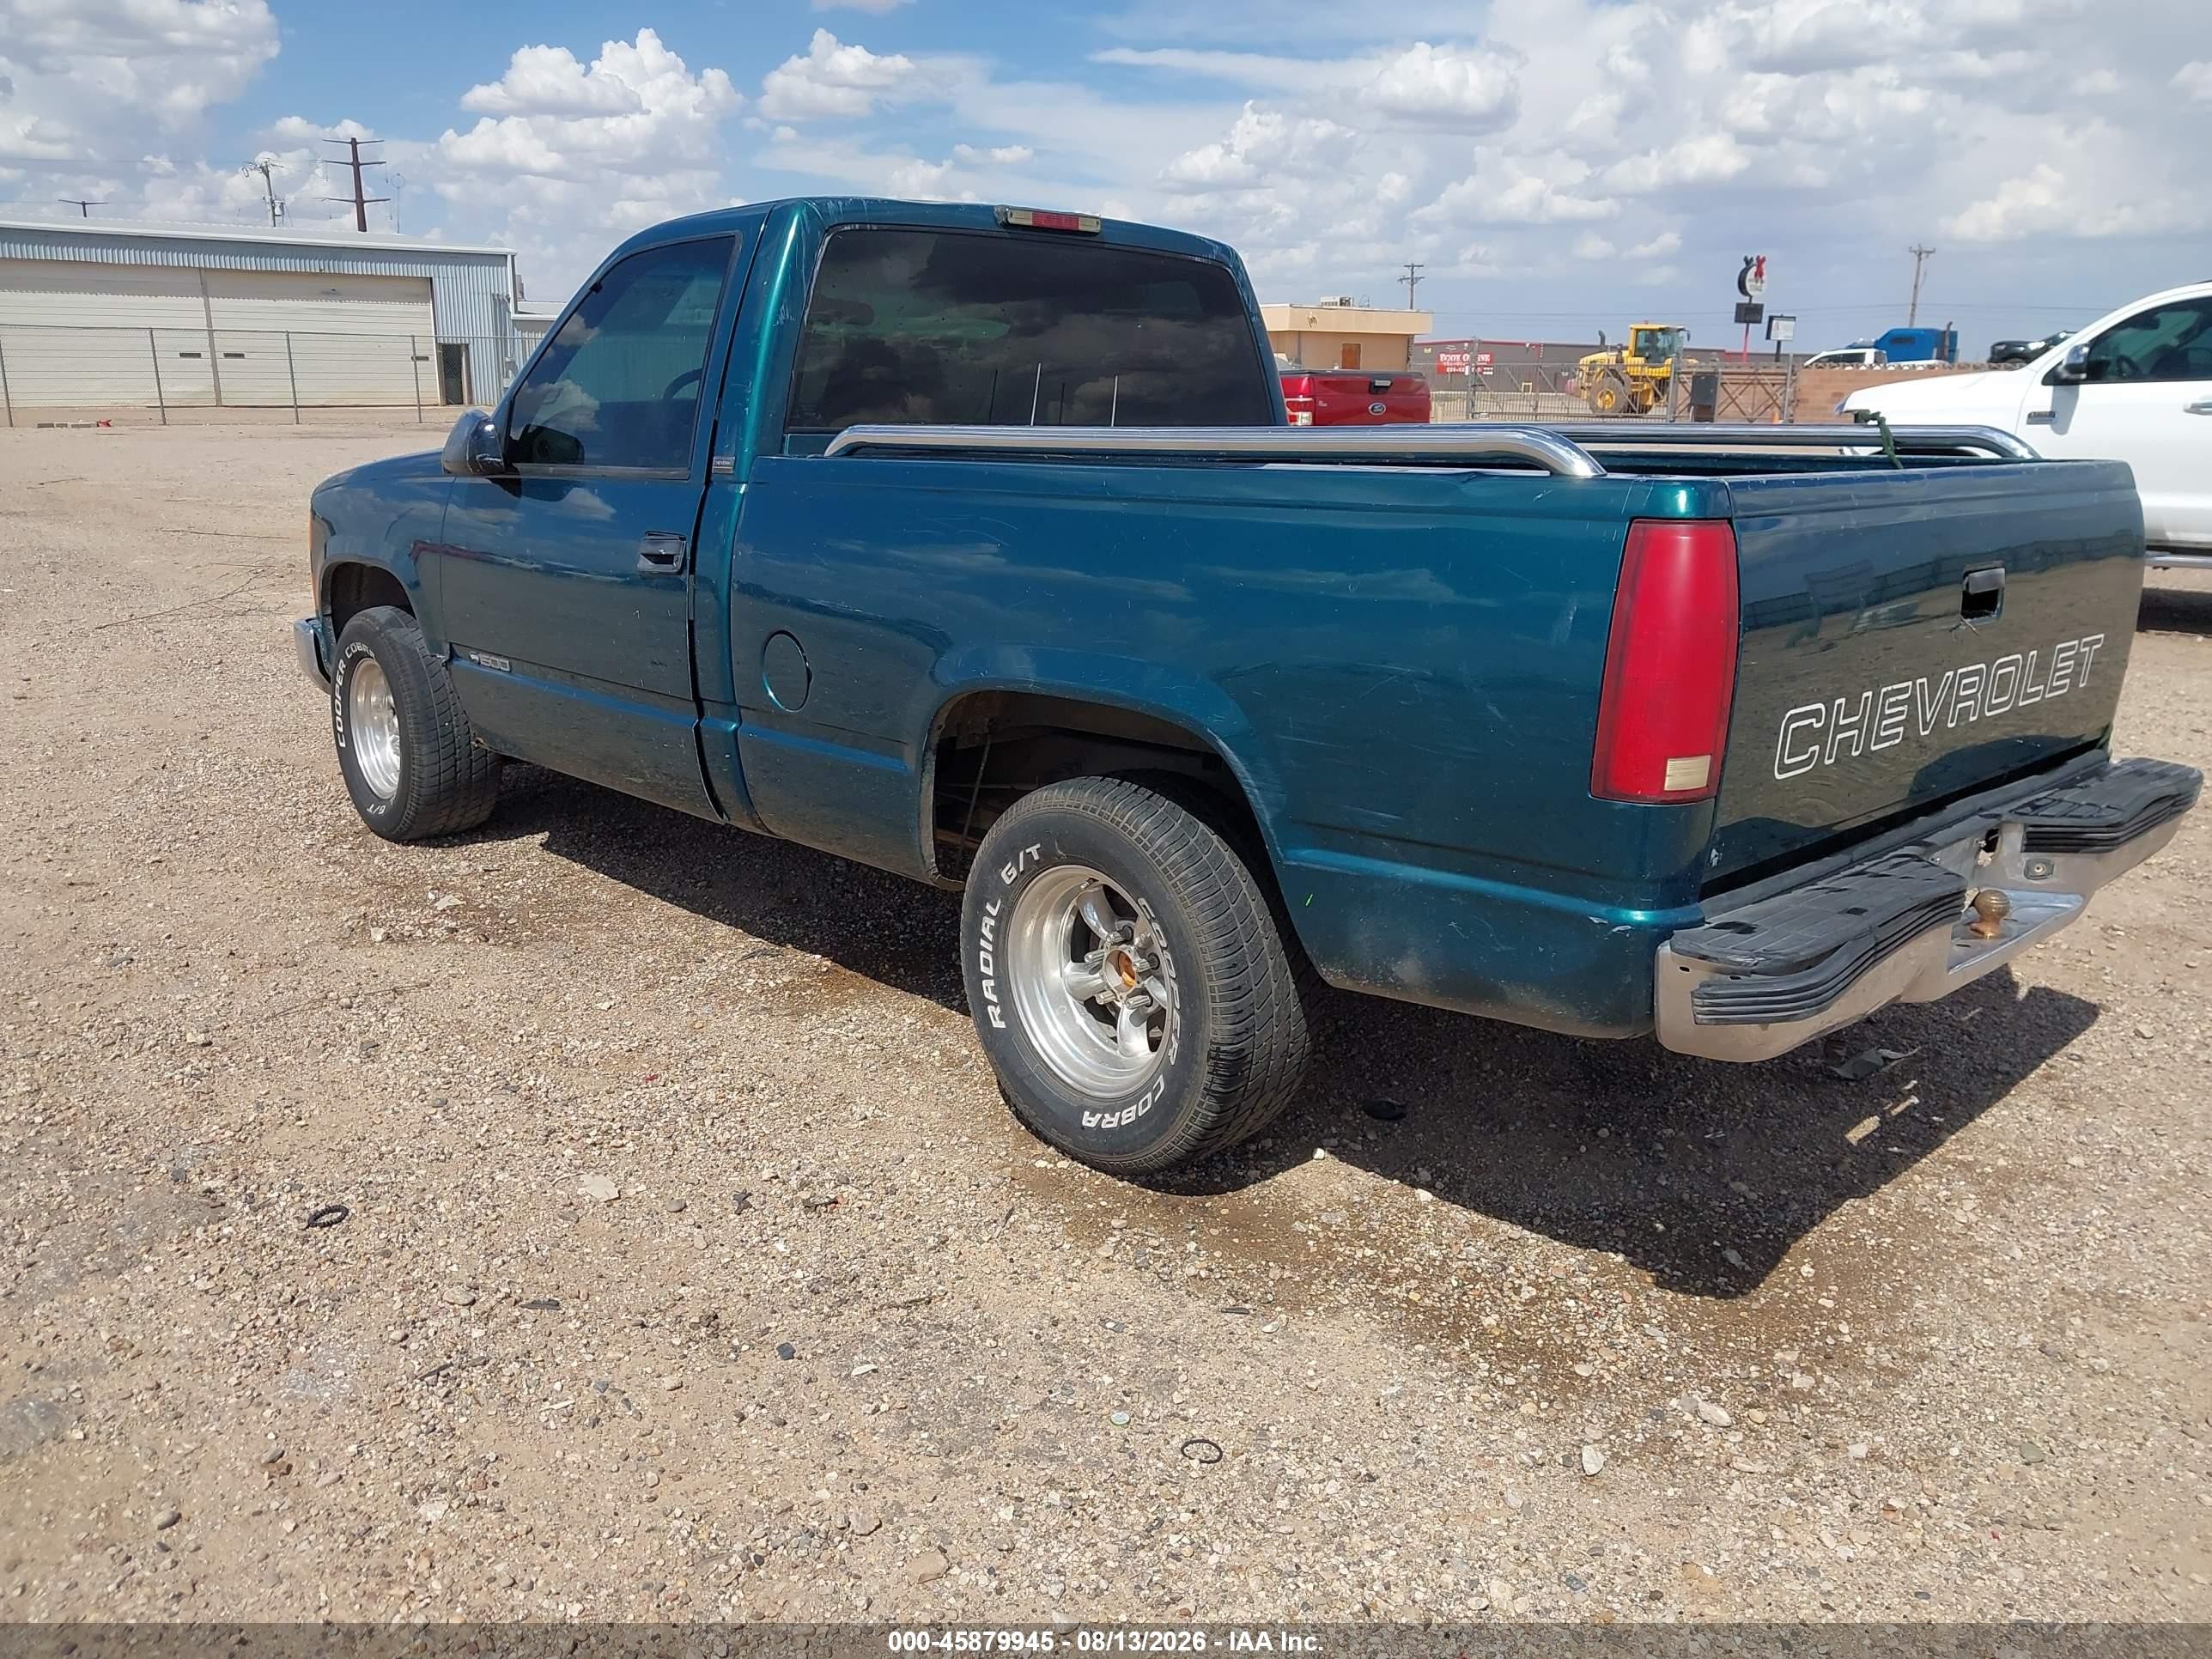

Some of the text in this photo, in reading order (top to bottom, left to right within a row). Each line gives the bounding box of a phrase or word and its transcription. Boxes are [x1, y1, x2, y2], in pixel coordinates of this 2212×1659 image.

[335, 641, 376, 749] COOPER COBRA
[1773, 633, 2106, 781] CHEVROLET
[979, 842, 1182, 1130] COOPER COBRA RADIAL G/T
